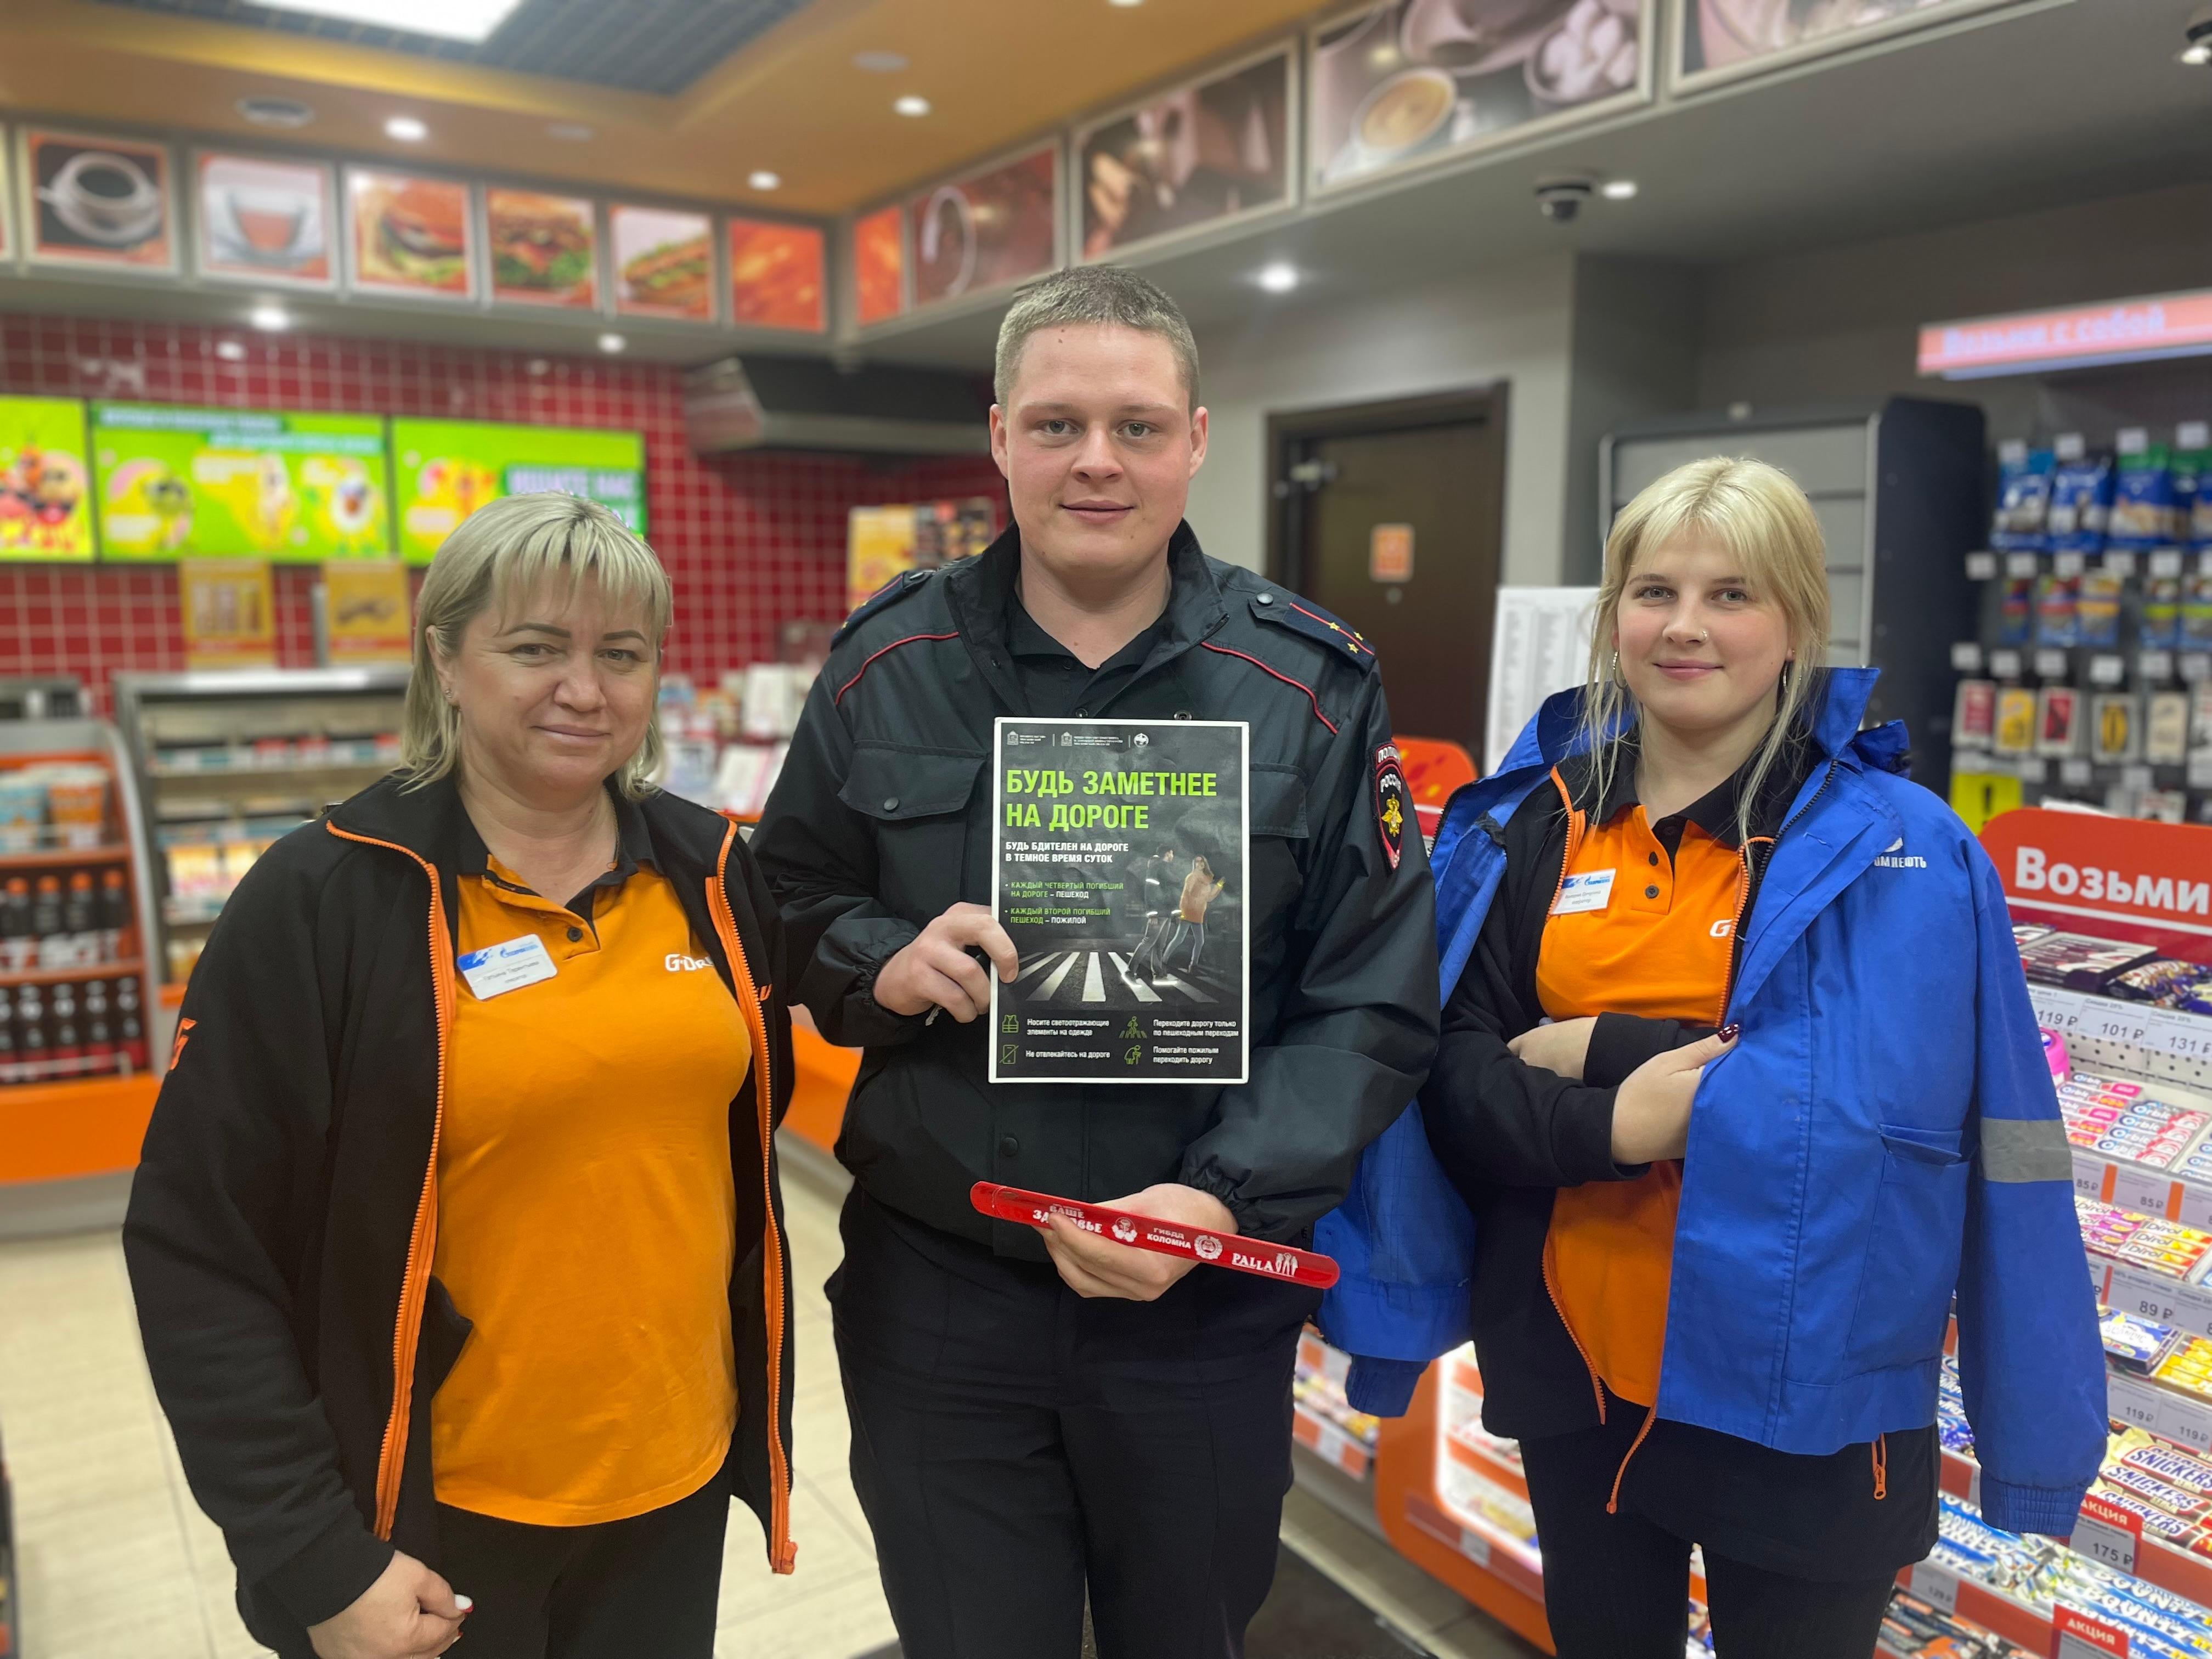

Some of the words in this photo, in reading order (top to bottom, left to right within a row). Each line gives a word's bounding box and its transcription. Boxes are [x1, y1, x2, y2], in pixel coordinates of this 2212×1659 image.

[1006, 770, 1074, 798] БУДЬ
[1083, 771, 1217, 797] ЗАМЕТНЕЕ
[1006, 804, 1041, 827] НА
[1048, 804, 1149, 832] ДОРОГЕ
[1006, 842, 1030, 851] БУДЬ
[1031, 842, 1077, 852] БДИТЕЛЕН
[1080, 843, 1092, 851] НА
[1094, 843, 1129, 853] ДОРОГЕ
[1005, 854, 1012, 862] В
[1014, 854, 1049, 862] ТЕМНОЕ
[1052, 854, 1082, 863] ВРЕМЯ
[1084, 854, 1113, 863] СУТОК
[1011, 881, 1043, 890] КАЖДЫЙ
[1045, 882, 1084, 890] ЧЕТВЕРТЫЙ
[1086, 882, 1124, 890] ПОГИБШИЙ
[2015, 845, 2210, 915] Возьми
[1022, 890, 1048, 899] ДОРОГЕ
[1056, 891, 1090, 899] ПЕШЕХОД
[1011, 907, 1042, 916] КАЖДЫЙ
[1045, 907, 1071, 915] ВТОРОЙ
[1073, 907, 1111, 916] ПОГИБШИЙ
[1011, 917, 1043, 925] ПЕШЕХОД
[1051, 916, 1087, 924] ПОЖИЛОЙ
[2038, 1010, 2063, 1025] 119
[2102, 1023, 2129, 1038] 101
[2170, 1036, 2197, 1052] 131
[1049, 1205, 1085, 1218] ВАШЕ
[1032, 1209, 1102, 1233] ЗДВЬЕ
[2145, 1222, 2182, 1234] Dirol
[1147, 1233, 1192, 1249] КОЛОМНА
[1153, 1227, 1184, 1240] ГИБДД
[2136, 1233, 2171, 1245] Dirol
[2127, 1245, 2163, 1257] Dirol
[1231, 1252, 1274, 1271] PALLA
[2139, 1301, 2158, 1316] 89
[2092, 1542, 2119, 1561] 175
[2086, 1587, 2194, 1641] BOUNTY
[2067, 1618, 2116, 1645] АКЦИЯ
